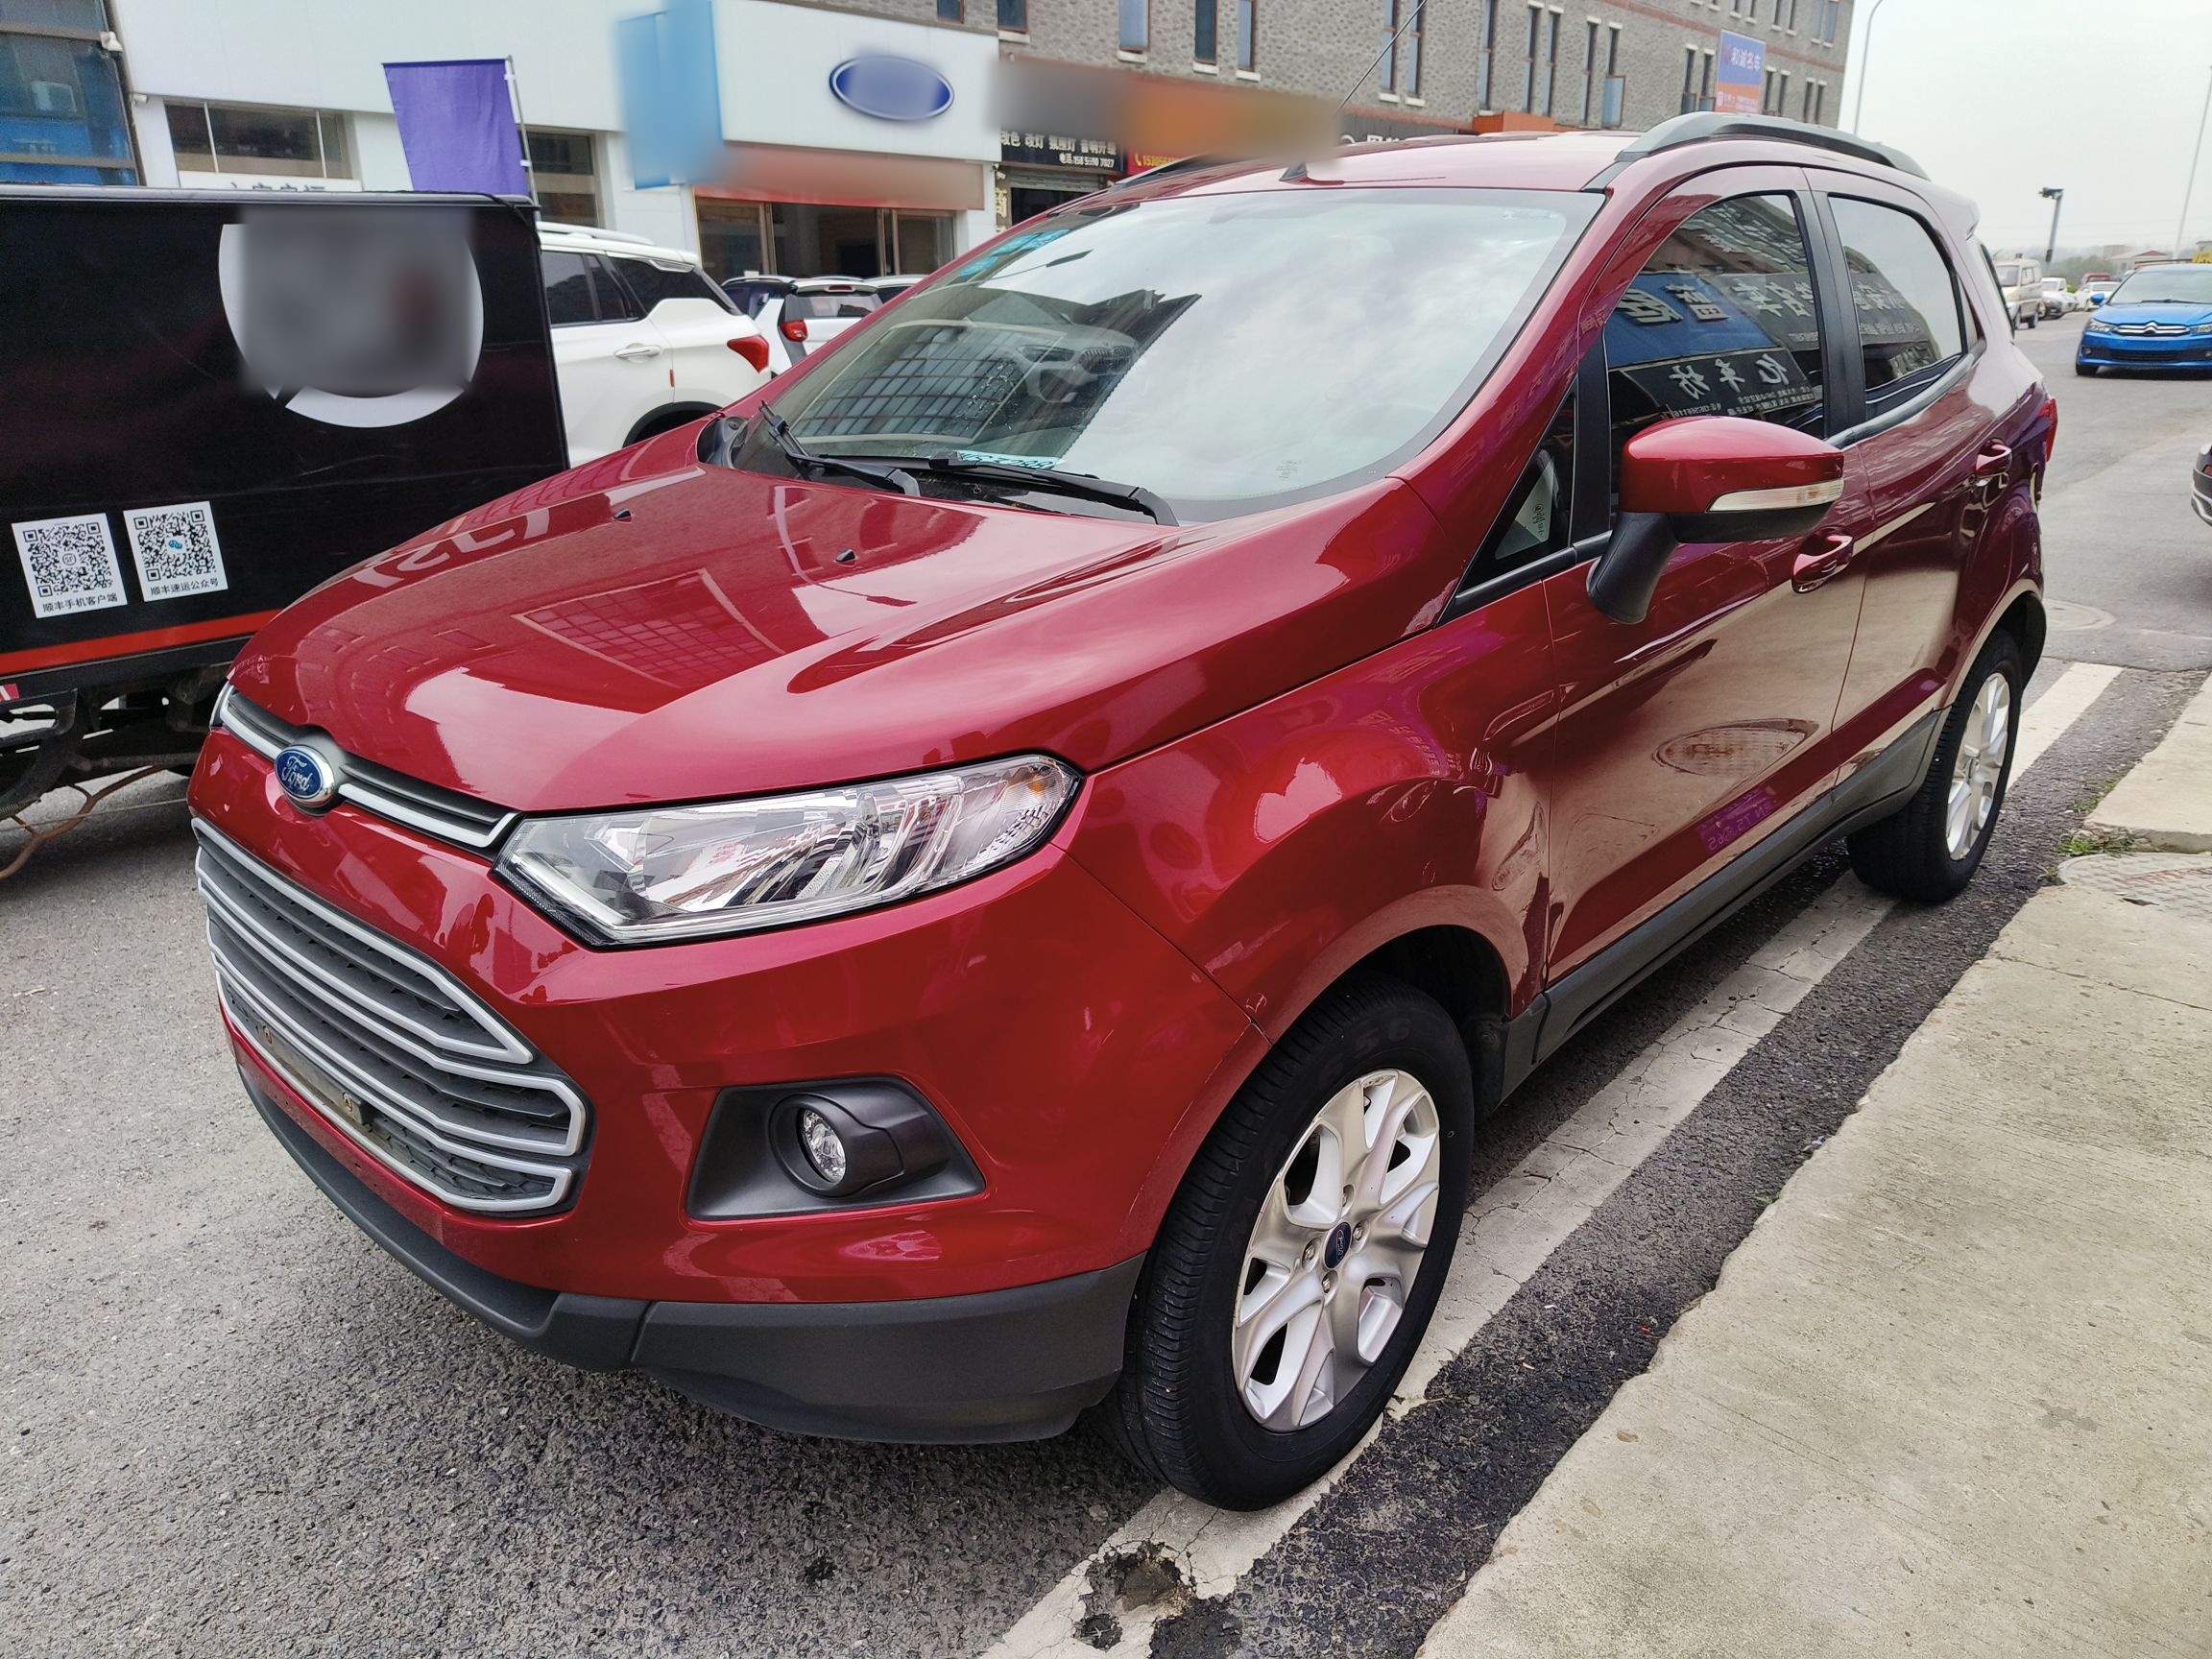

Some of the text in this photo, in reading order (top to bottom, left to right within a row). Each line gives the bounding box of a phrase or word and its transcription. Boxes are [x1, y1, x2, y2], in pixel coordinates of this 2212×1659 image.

[150, 578, 219, 597] 顺丰速运公众号
[43, 592, 118, 613] 顺丰手机客户端
[281, 756, 313, 792] Ford
